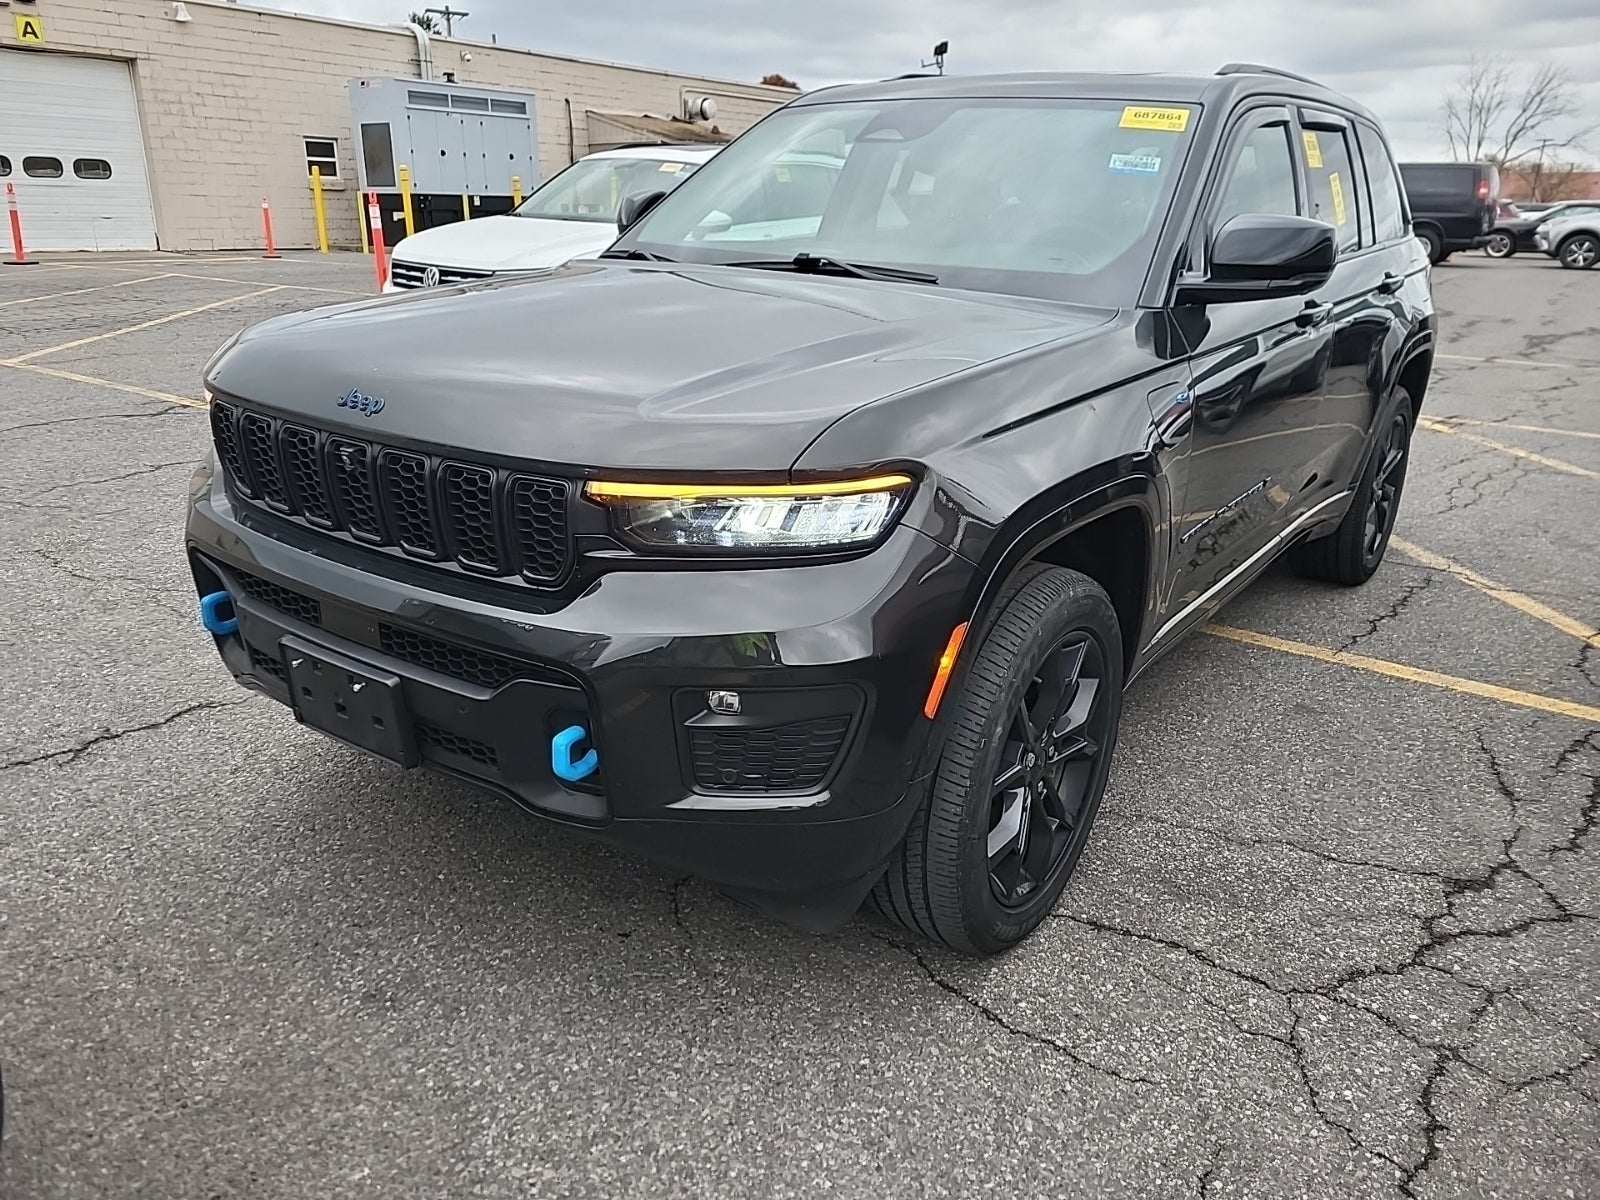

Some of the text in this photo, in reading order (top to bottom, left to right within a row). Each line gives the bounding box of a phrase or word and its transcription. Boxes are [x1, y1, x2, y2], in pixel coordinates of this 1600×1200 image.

[22, 21, 39, 39] A
[1133, 111, 1182, 121] 687864
[337, 388, 385, 417] Jeep
